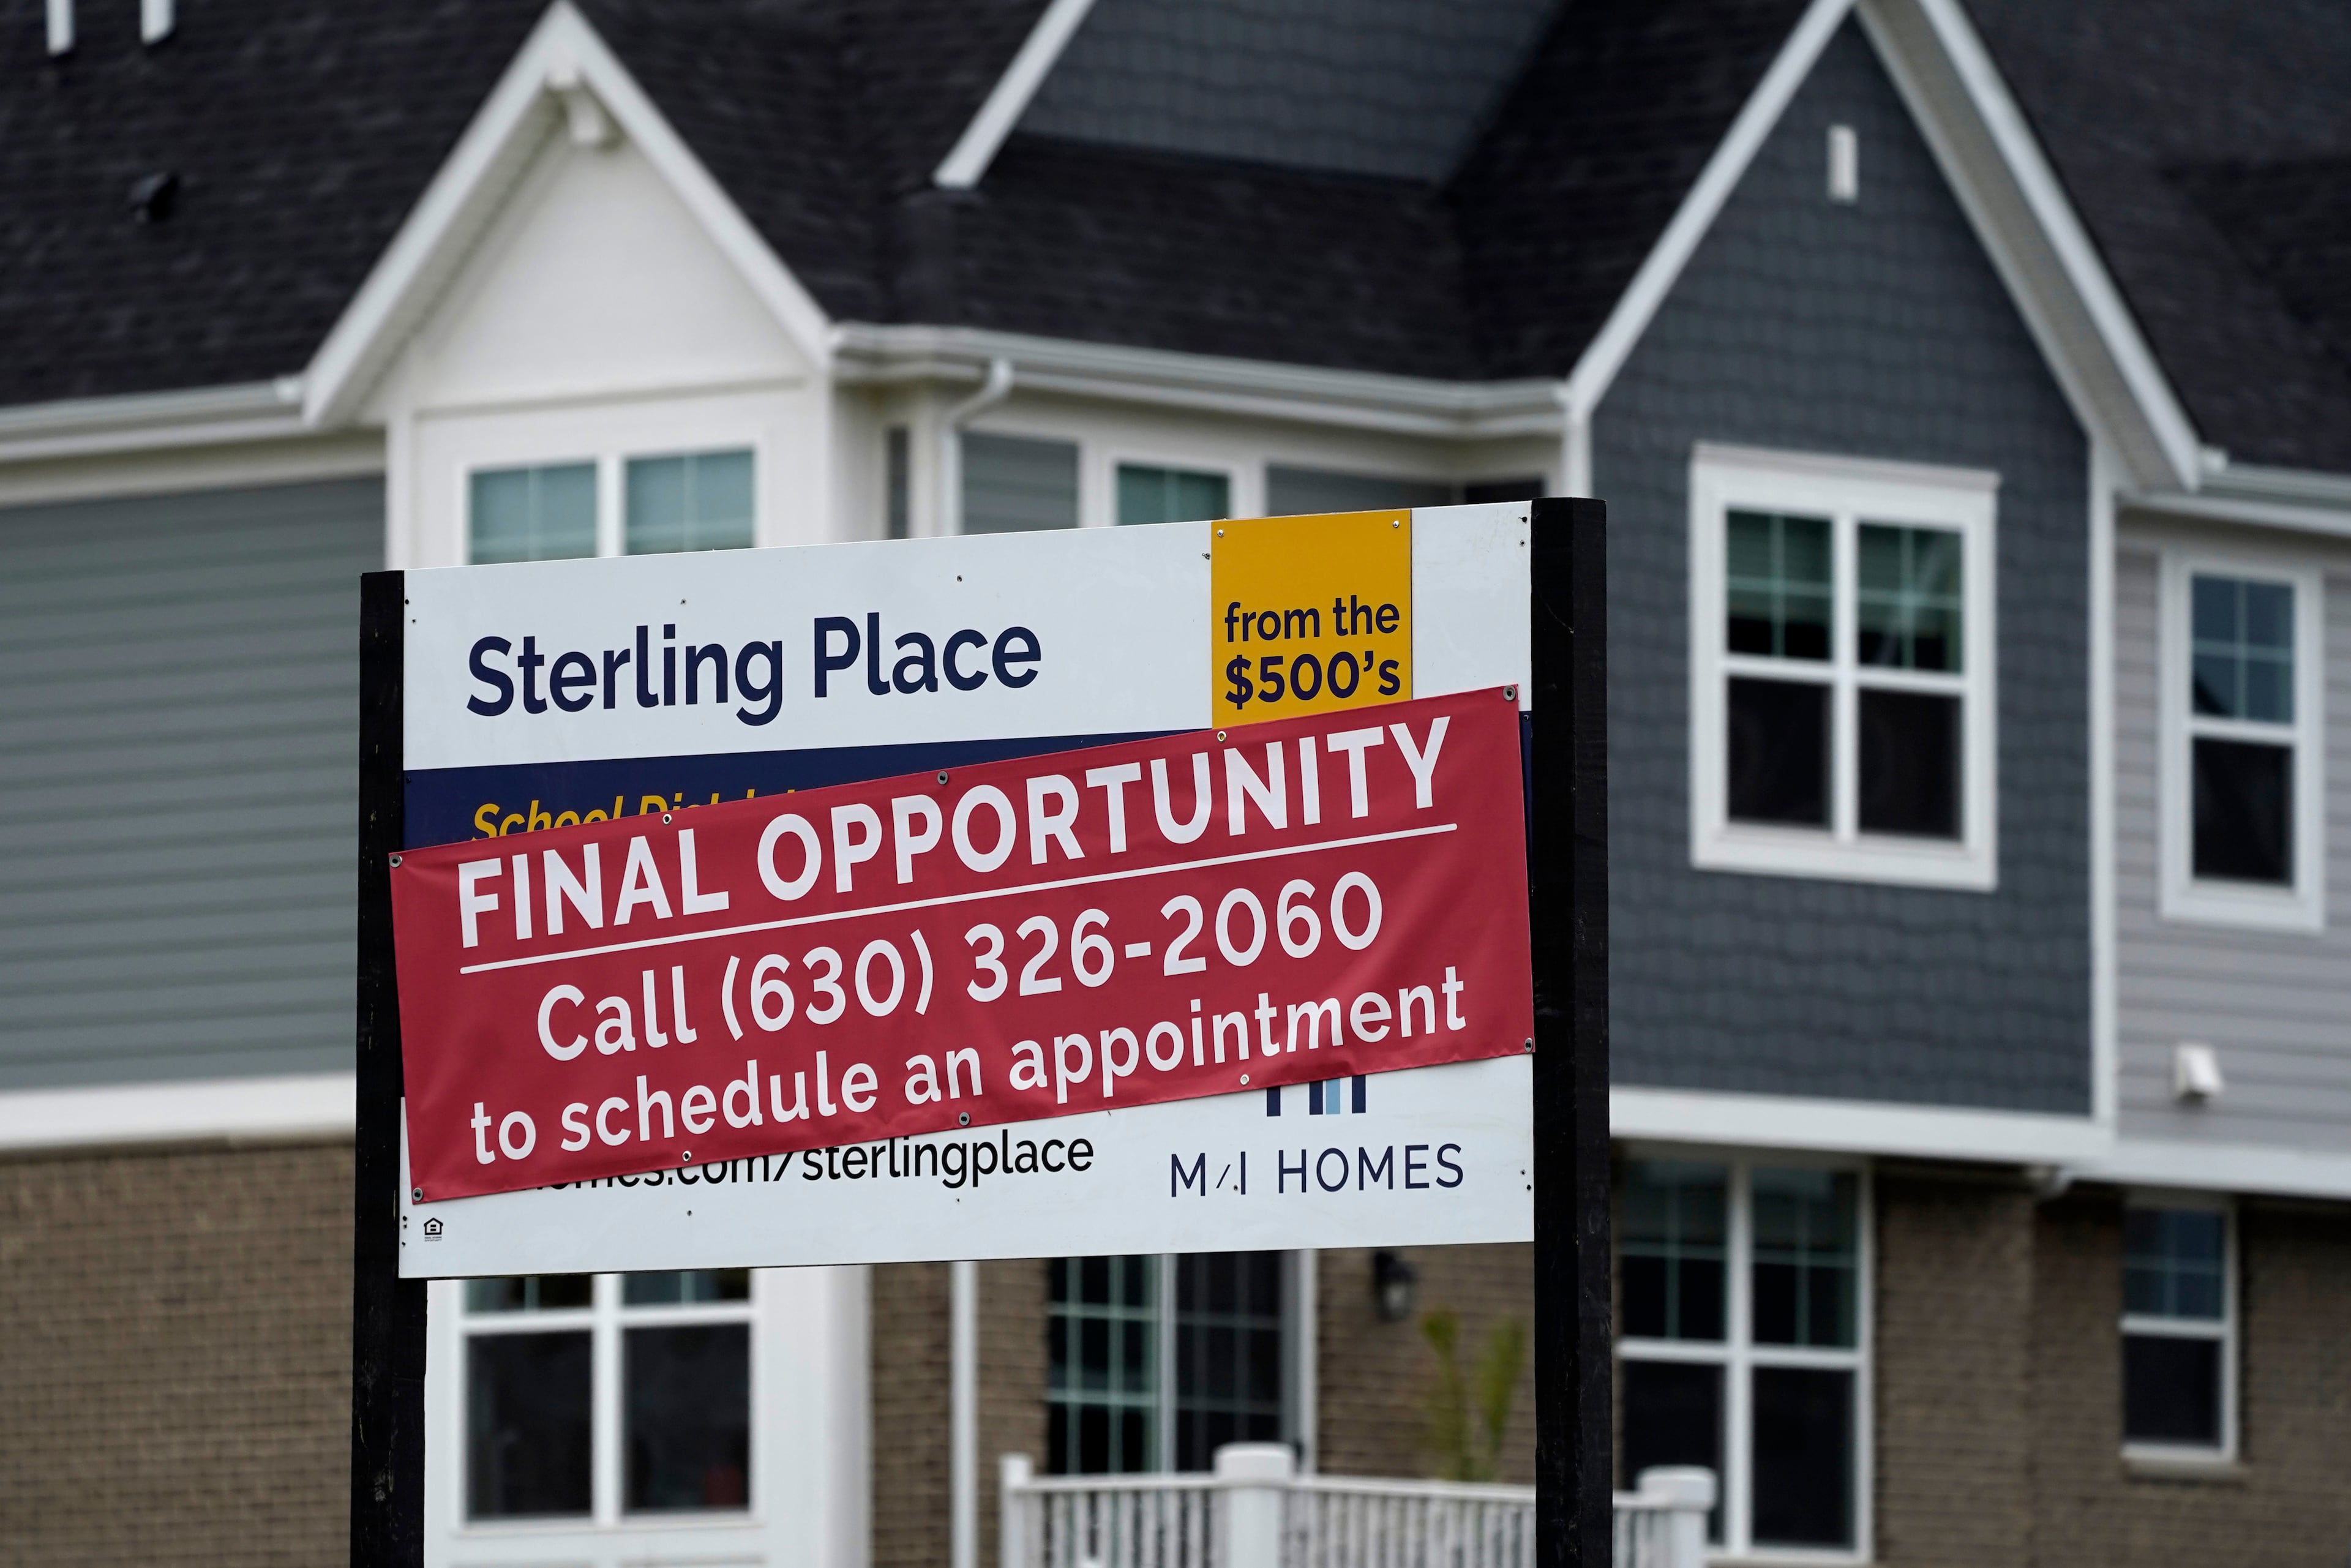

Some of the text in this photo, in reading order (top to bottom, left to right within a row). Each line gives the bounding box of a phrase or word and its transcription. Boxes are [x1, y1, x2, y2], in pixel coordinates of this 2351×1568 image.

[467, 612, 1041, 727] Sterling Place
[1225, 595, 1400, 643] from the
[1226, 650, 1400, 710] $500's
[458, 716, 1451, 948] FINAL OPPORTUNITY
[537, 871, 1383, 1061] Call (630) 326-2060
[470, 966, 1466, 1165] to schedule an appointment
[1278, 1143, 1463, 1194] HOMES
